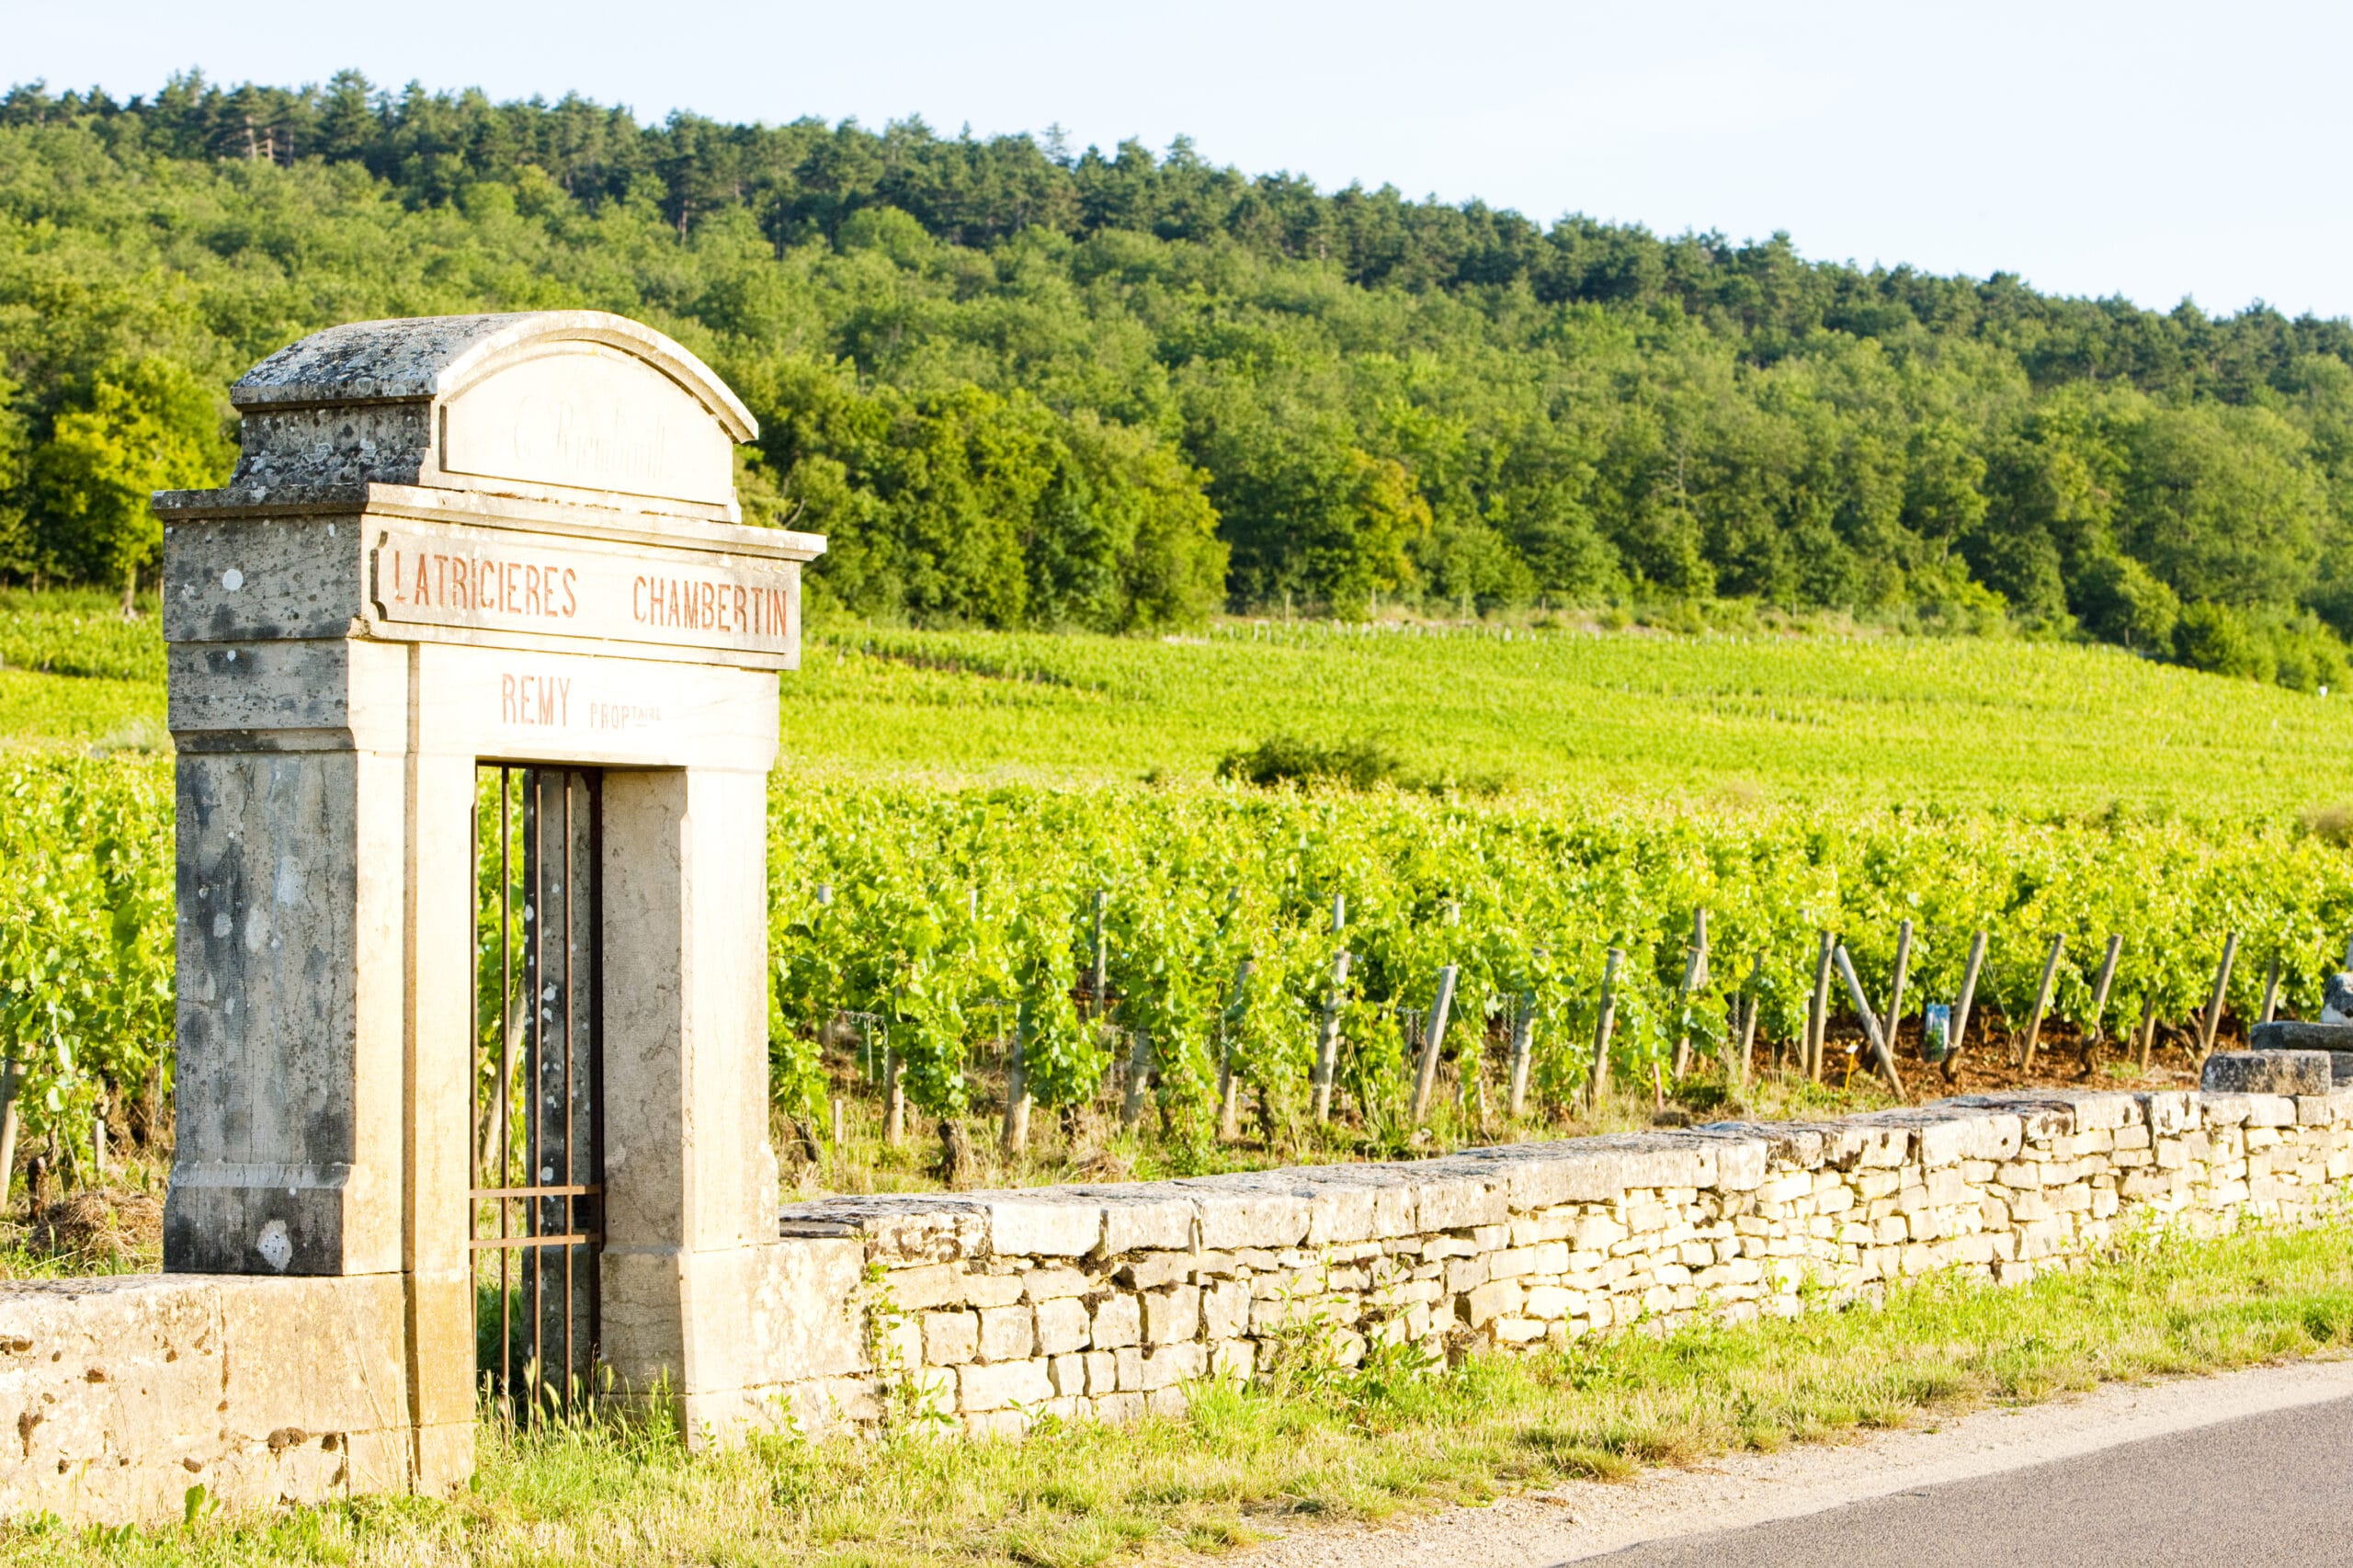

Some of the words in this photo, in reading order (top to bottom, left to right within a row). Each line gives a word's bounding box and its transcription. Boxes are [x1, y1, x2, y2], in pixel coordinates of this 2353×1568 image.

[394, 551, 577, 618] LATRICIERES
[633, 575, 788, 637] CHAMBERTIN
[502, 673, 571, 727] REMY
